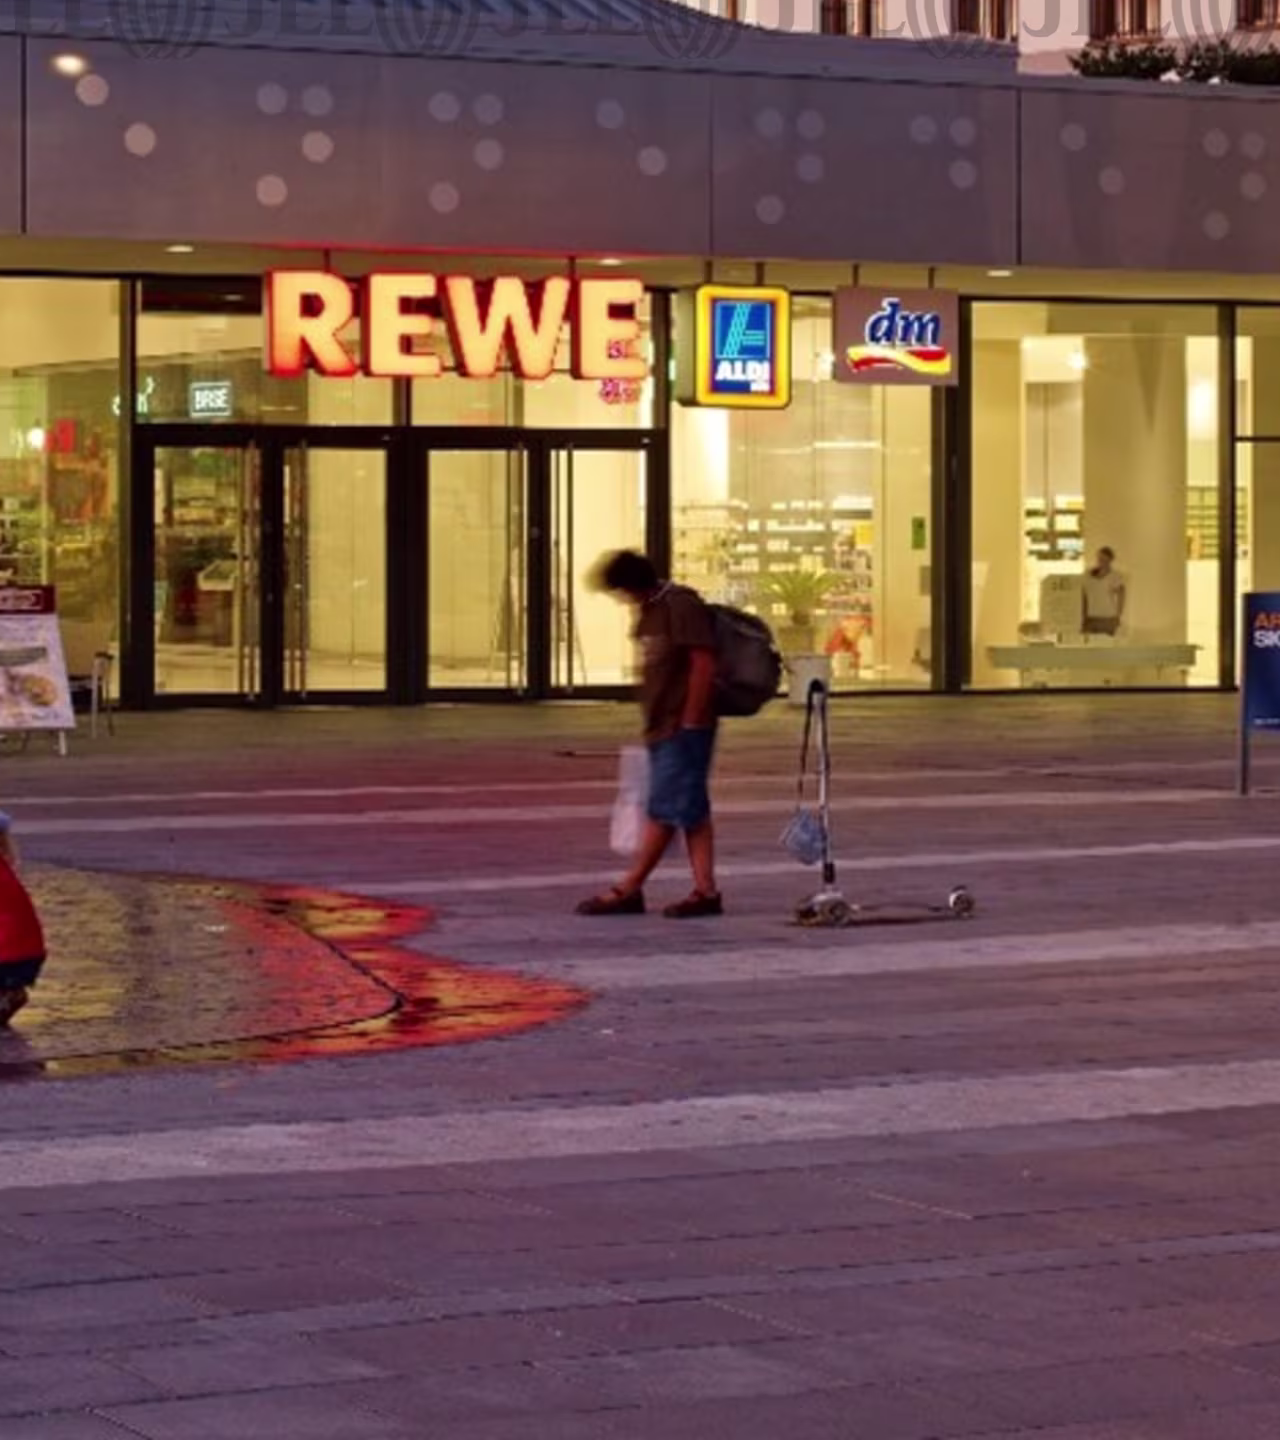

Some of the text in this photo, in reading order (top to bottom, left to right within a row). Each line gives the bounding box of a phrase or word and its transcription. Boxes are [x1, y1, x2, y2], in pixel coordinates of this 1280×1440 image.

[267, 270, 648, 381] REWE
[865, 297, 941, 347] dm
[714, 359, 771, 381] ALDI
